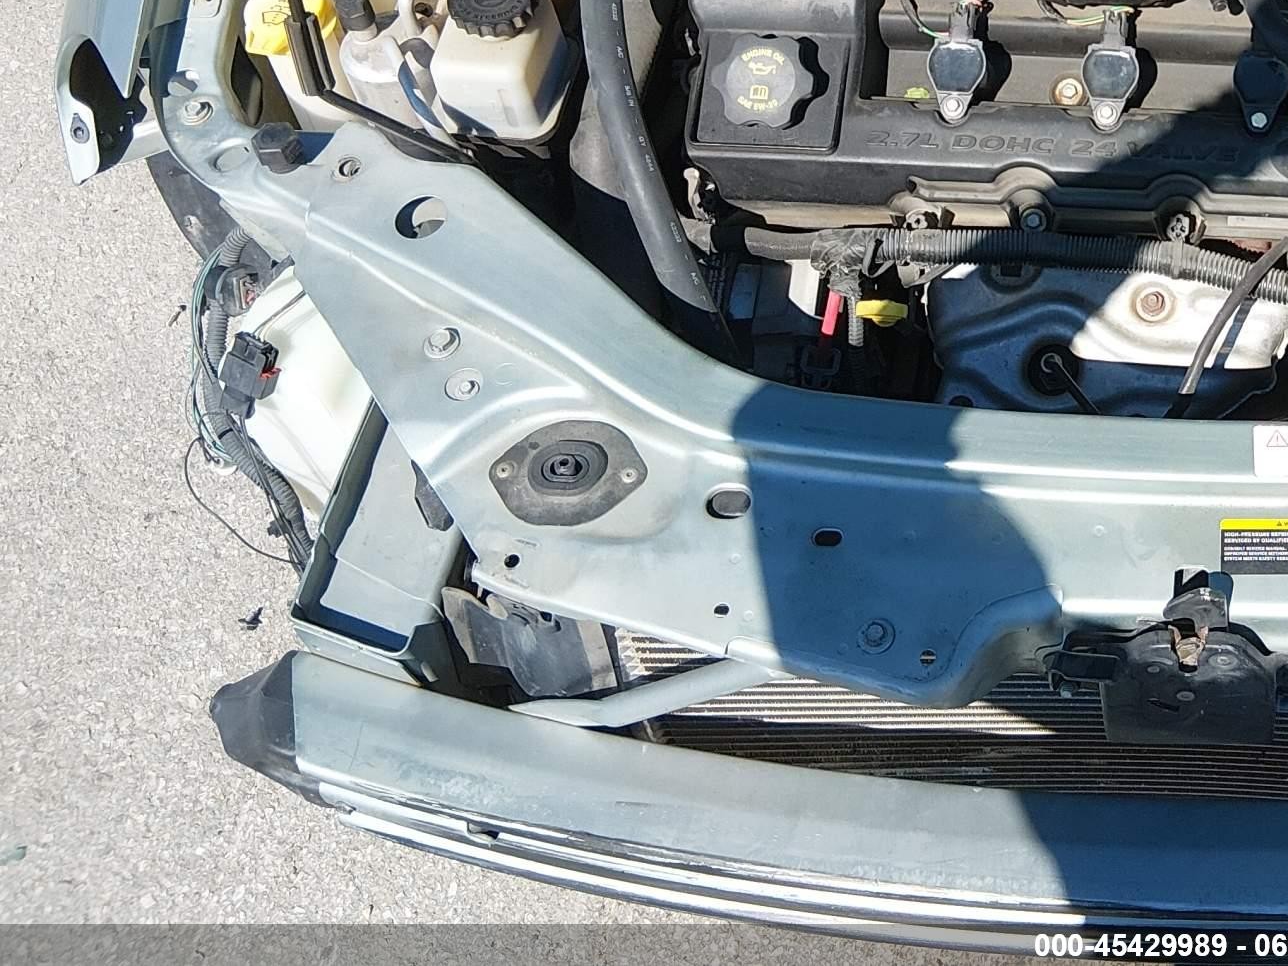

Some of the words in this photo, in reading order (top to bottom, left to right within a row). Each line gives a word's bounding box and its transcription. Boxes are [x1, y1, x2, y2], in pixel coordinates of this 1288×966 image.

[740, 47, 773, 62] ENGINE
[772, 52, 786, 65] OIL
[864, 129, 939, 149] 2.7L
[951, 133, 1055, 155] DOHC
[1071, 139, 1117, 157] 24
[1126, 141, 1241, 163] VALVE
